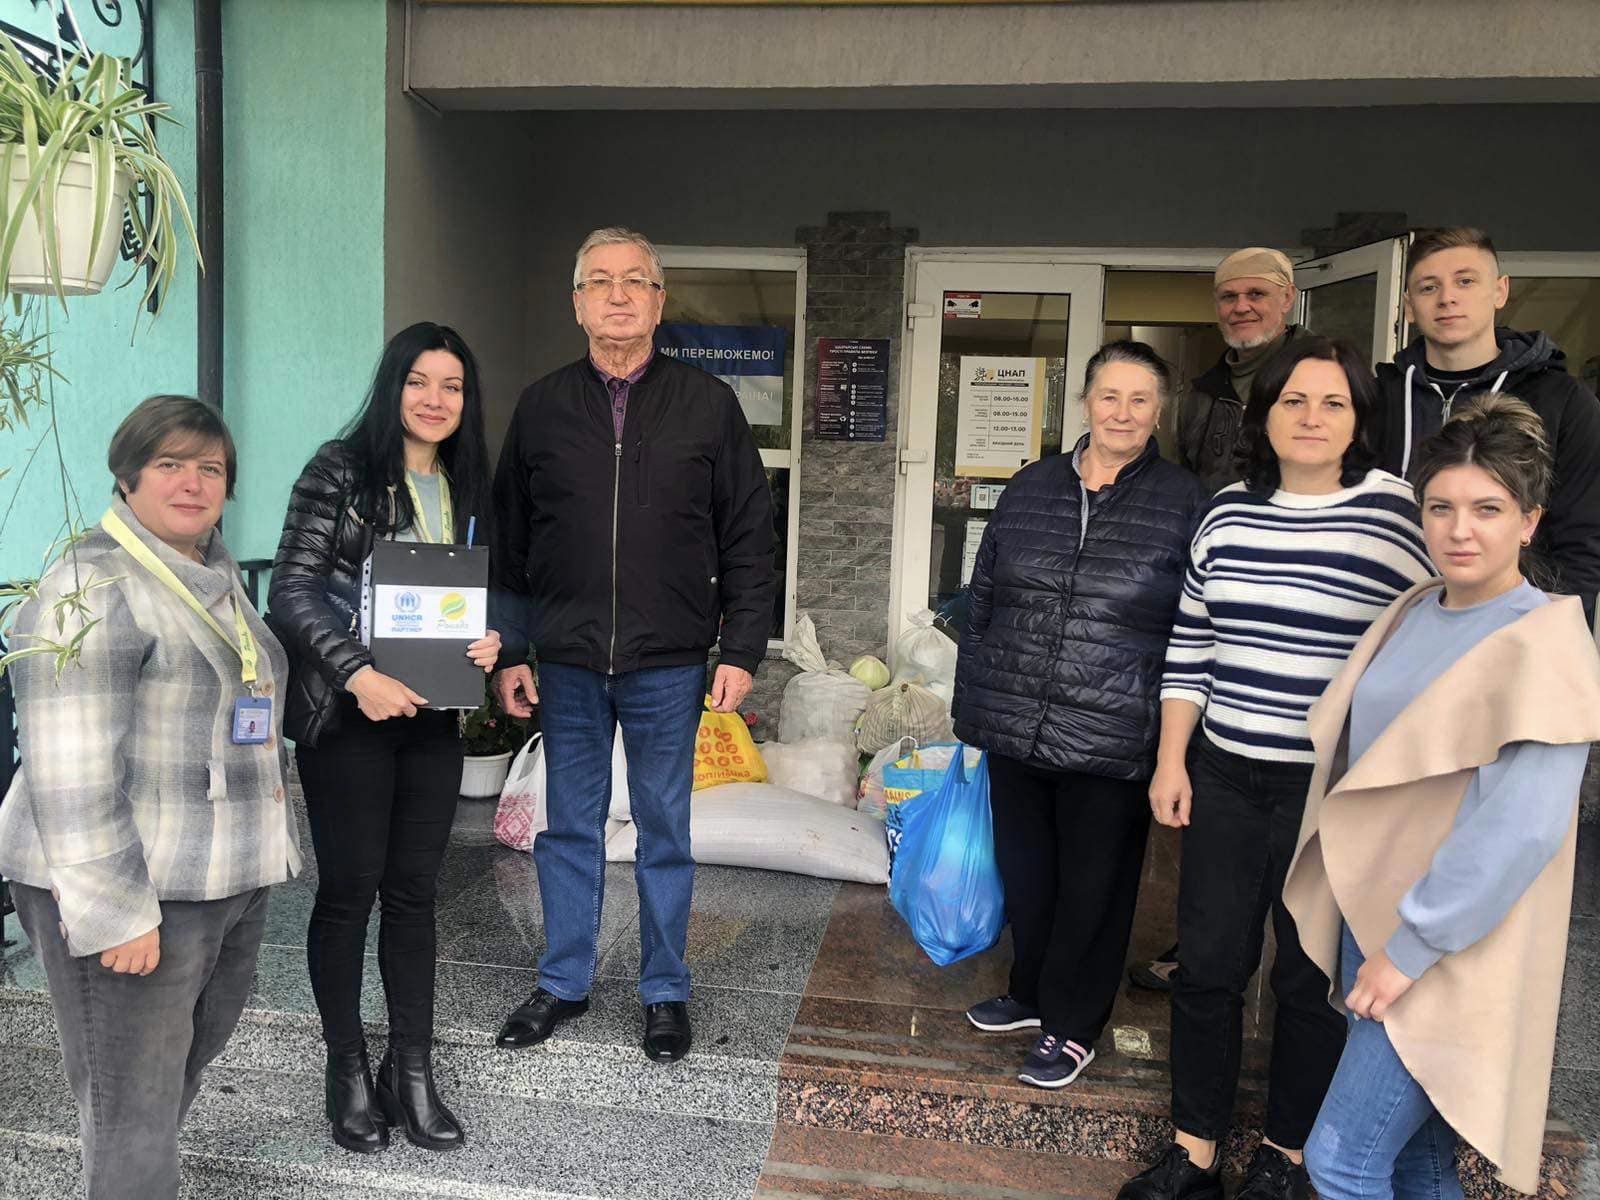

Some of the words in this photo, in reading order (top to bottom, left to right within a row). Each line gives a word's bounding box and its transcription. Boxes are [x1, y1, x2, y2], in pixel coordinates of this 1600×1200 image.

[660, 347, 679, 358] МИ
[682, 348, 775, 361] ПЕРЕМОЖЕМО!
[997, 369, 1026, 378] ЦНАП
[391, 614, 423, 622] UNHCR
